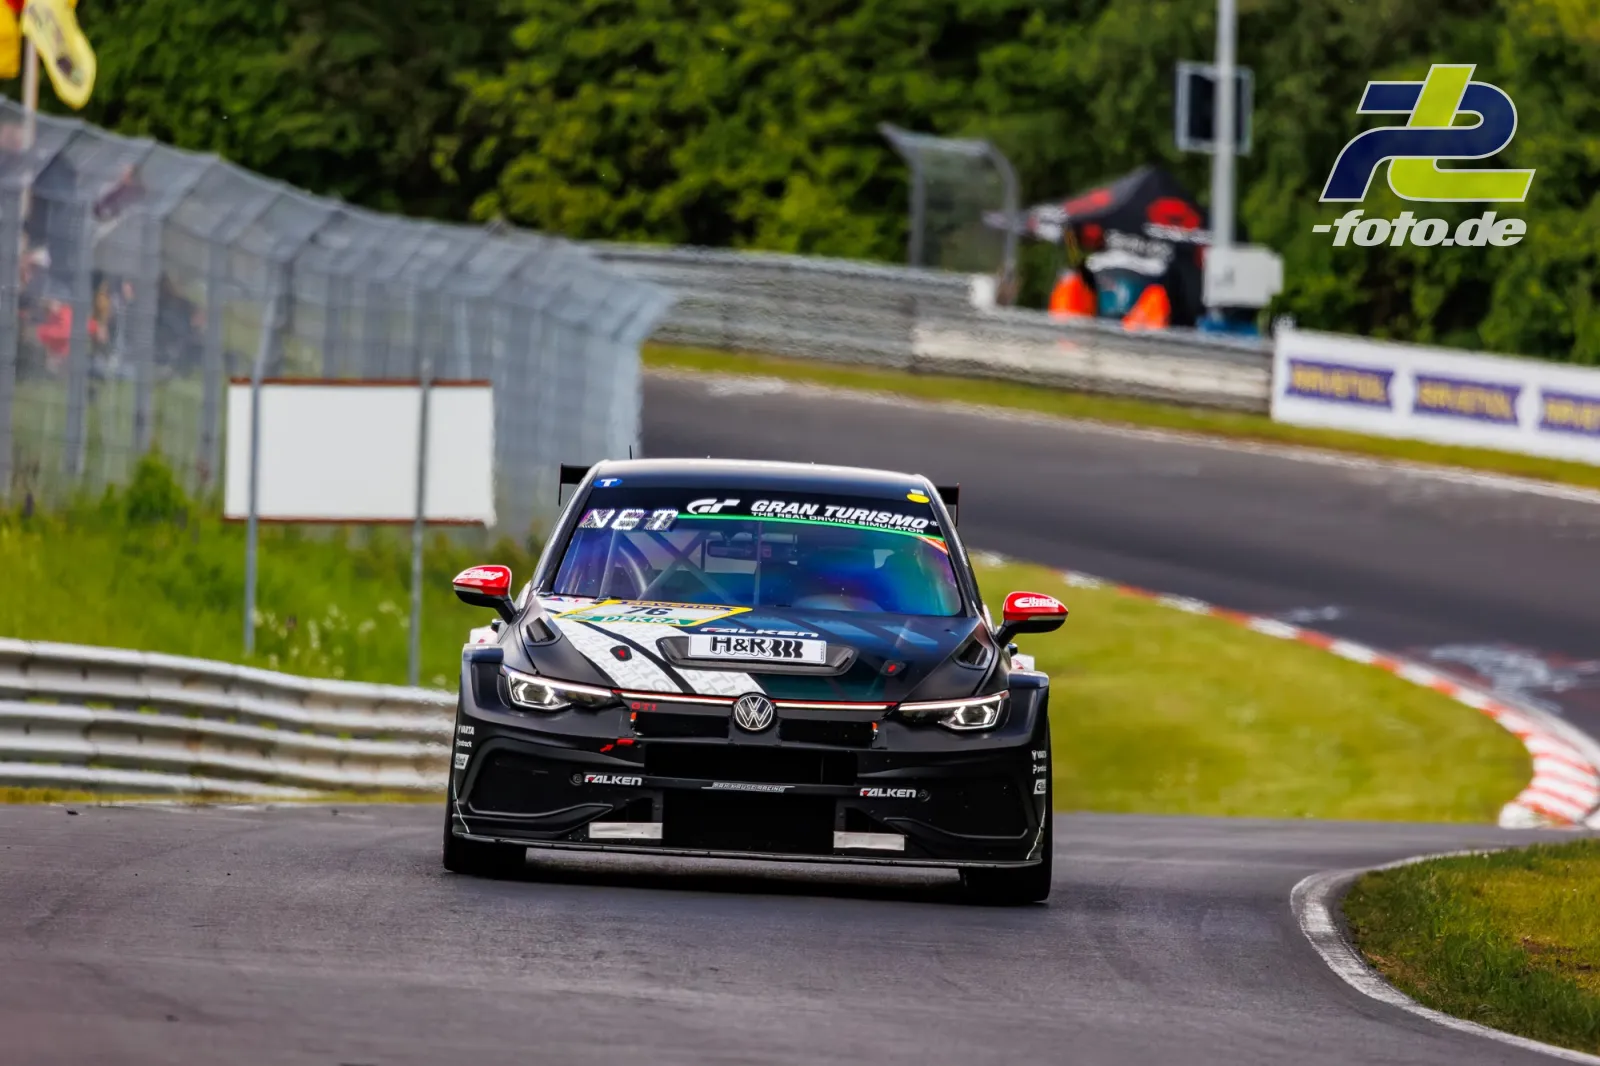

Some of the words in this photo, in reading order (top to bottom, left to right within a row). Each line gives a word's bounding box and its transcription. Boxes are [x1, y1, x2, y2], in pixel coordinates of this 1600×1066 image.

[750, 499, 820, 516] GRAN
[823, 504, 930, 529] TURISMO
[809, 515, 856, 525] DRIVING
[858, 519, 925, 534] SIMULATOR
[624, 606, 673, 616] 76
[600, 615, 681, 625] DEKRA
[700, 627, 819, 638] FALKEN
[710, 636, 770, 657] H&R
[631, 702, 657, 711] GTI
[584, 774, 642, 786] FALKEN
[859, 787, 917, 798] FALKEN
